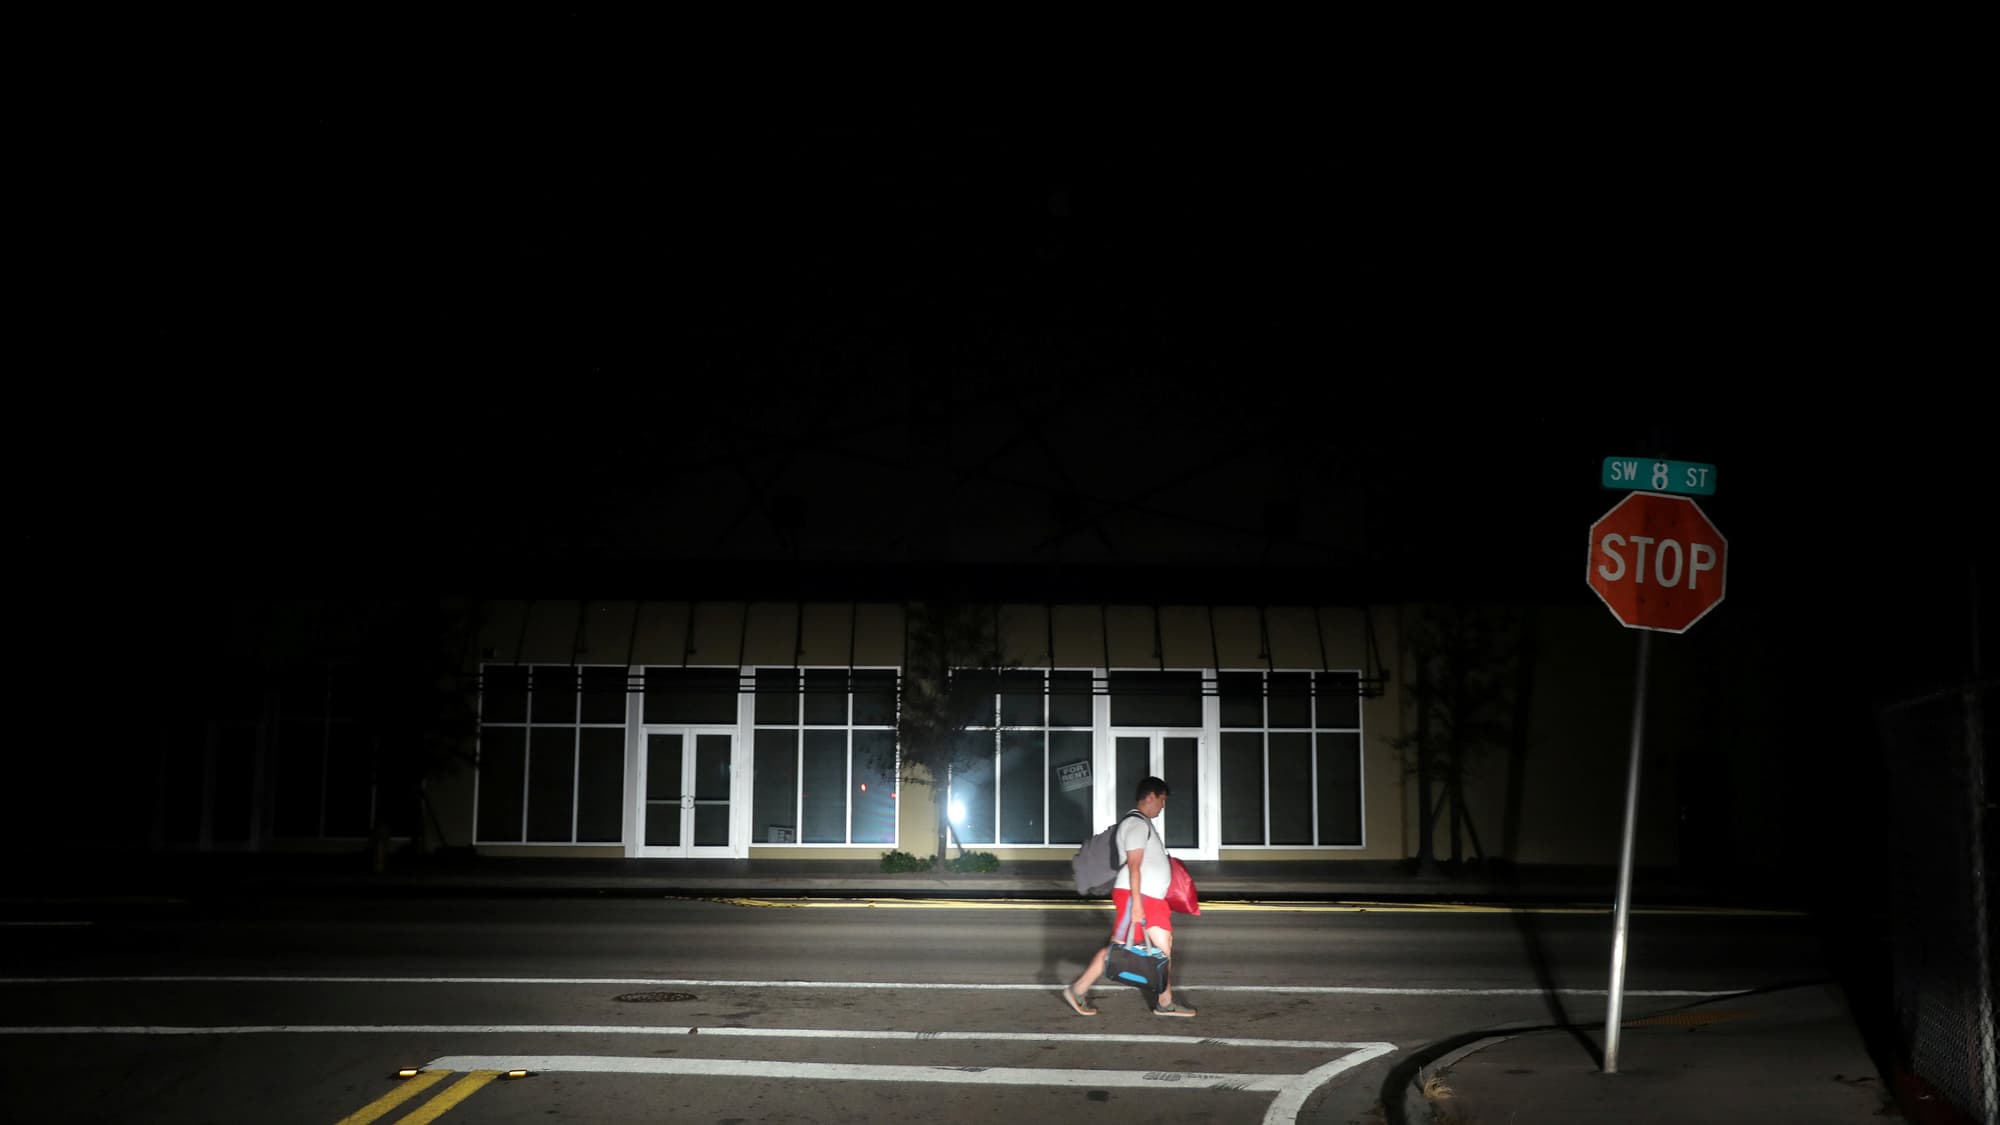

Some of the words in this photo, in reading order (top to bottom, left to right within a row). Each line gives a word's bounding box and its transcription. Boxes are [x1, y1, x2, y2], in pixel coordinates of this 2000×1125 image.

[1611, 461, 1638, 481] SW
[1652, 462, 1669, 490] 8
[1686, 467, 1709, 488] ST
[1598, 533, 1717, 590] STOP
[1062, 770, 1088, 781] RENT
[1063, 765, 1084, 775] FOR
